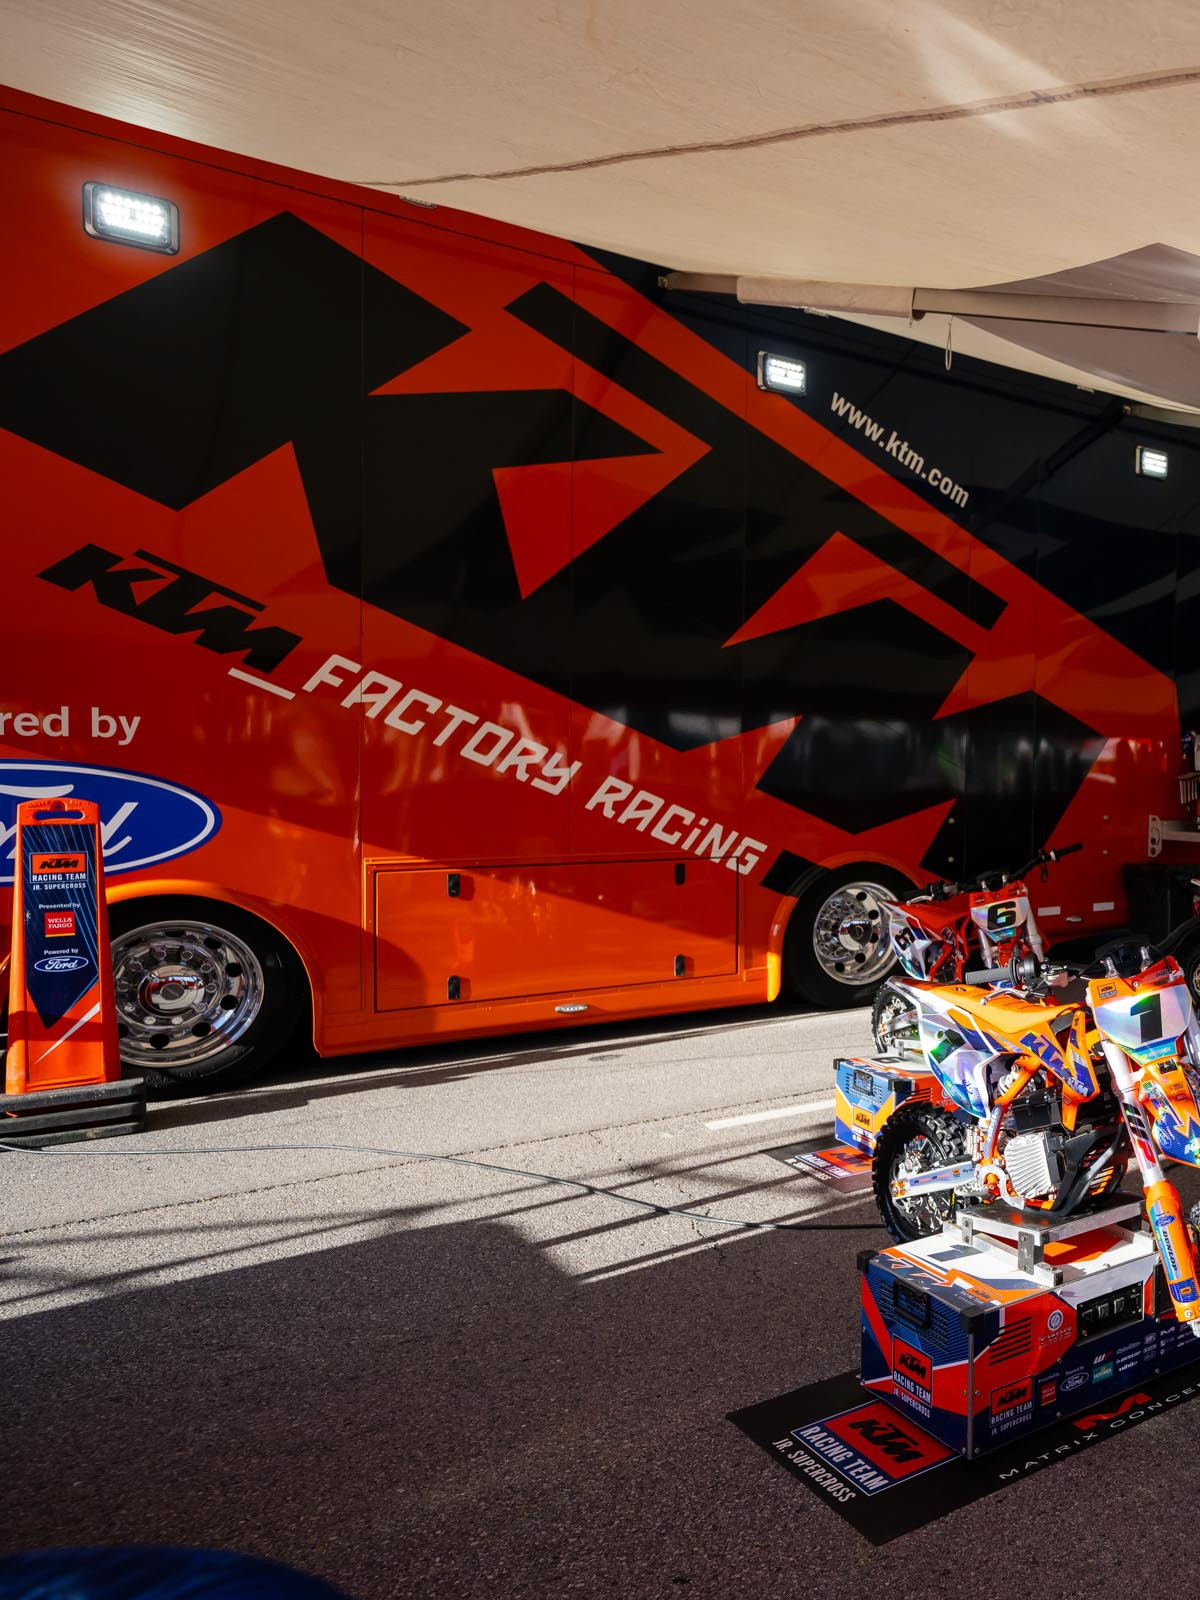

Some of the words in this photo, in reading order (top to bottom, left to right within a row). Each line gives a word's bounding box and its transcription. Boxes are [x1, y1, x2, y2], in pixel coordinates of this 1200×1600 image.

[831, 391, 970, 508] www.ktm.com
[36, 543, 303, 674] KTM
[302, 653, 582, 798] FACTORY
[0, 706, 70, 737] red
[91, 707, 141, 745] by
[32, 874, 63, 882] RACING
[39, 859, 79, 870] KTM
[988, 901, 1016, 931] 6
[45, 958, 77, 970] Ford
[1130, 993, 1163, 1044] 1
[856, 1113, 870, 1126] KTM
[1162, 1230, 1178, 1272] DUNLOP
[899, 1353, 926, 1379] KTM
[893, 1371, 914, 1392] RACING
[915, 1385, 931, 1404] TEAM
[998, 1387, 1027, 1405] KTM
[1065, 1375, 1084, 1389] Ford
[901, 1391, 931, 1418] SUPERCROSS
[991, 1408, 1014, 1424] RACING
[1016, 1401, 1032, 1414] TEAM
[1000, 1412, 1032, 1431] SUPERCROSS
[848, 1419, 923, 1464] KTM
[999, 1432, 1099, 1480] MATRIX
[772, 1438, 787, 1453] JR.
[787, 1450, 857, 1503] SUPERCROSS
[799, 1426, 852, 1463] RACING
[849, 1459, 889, 1491] TEAM
